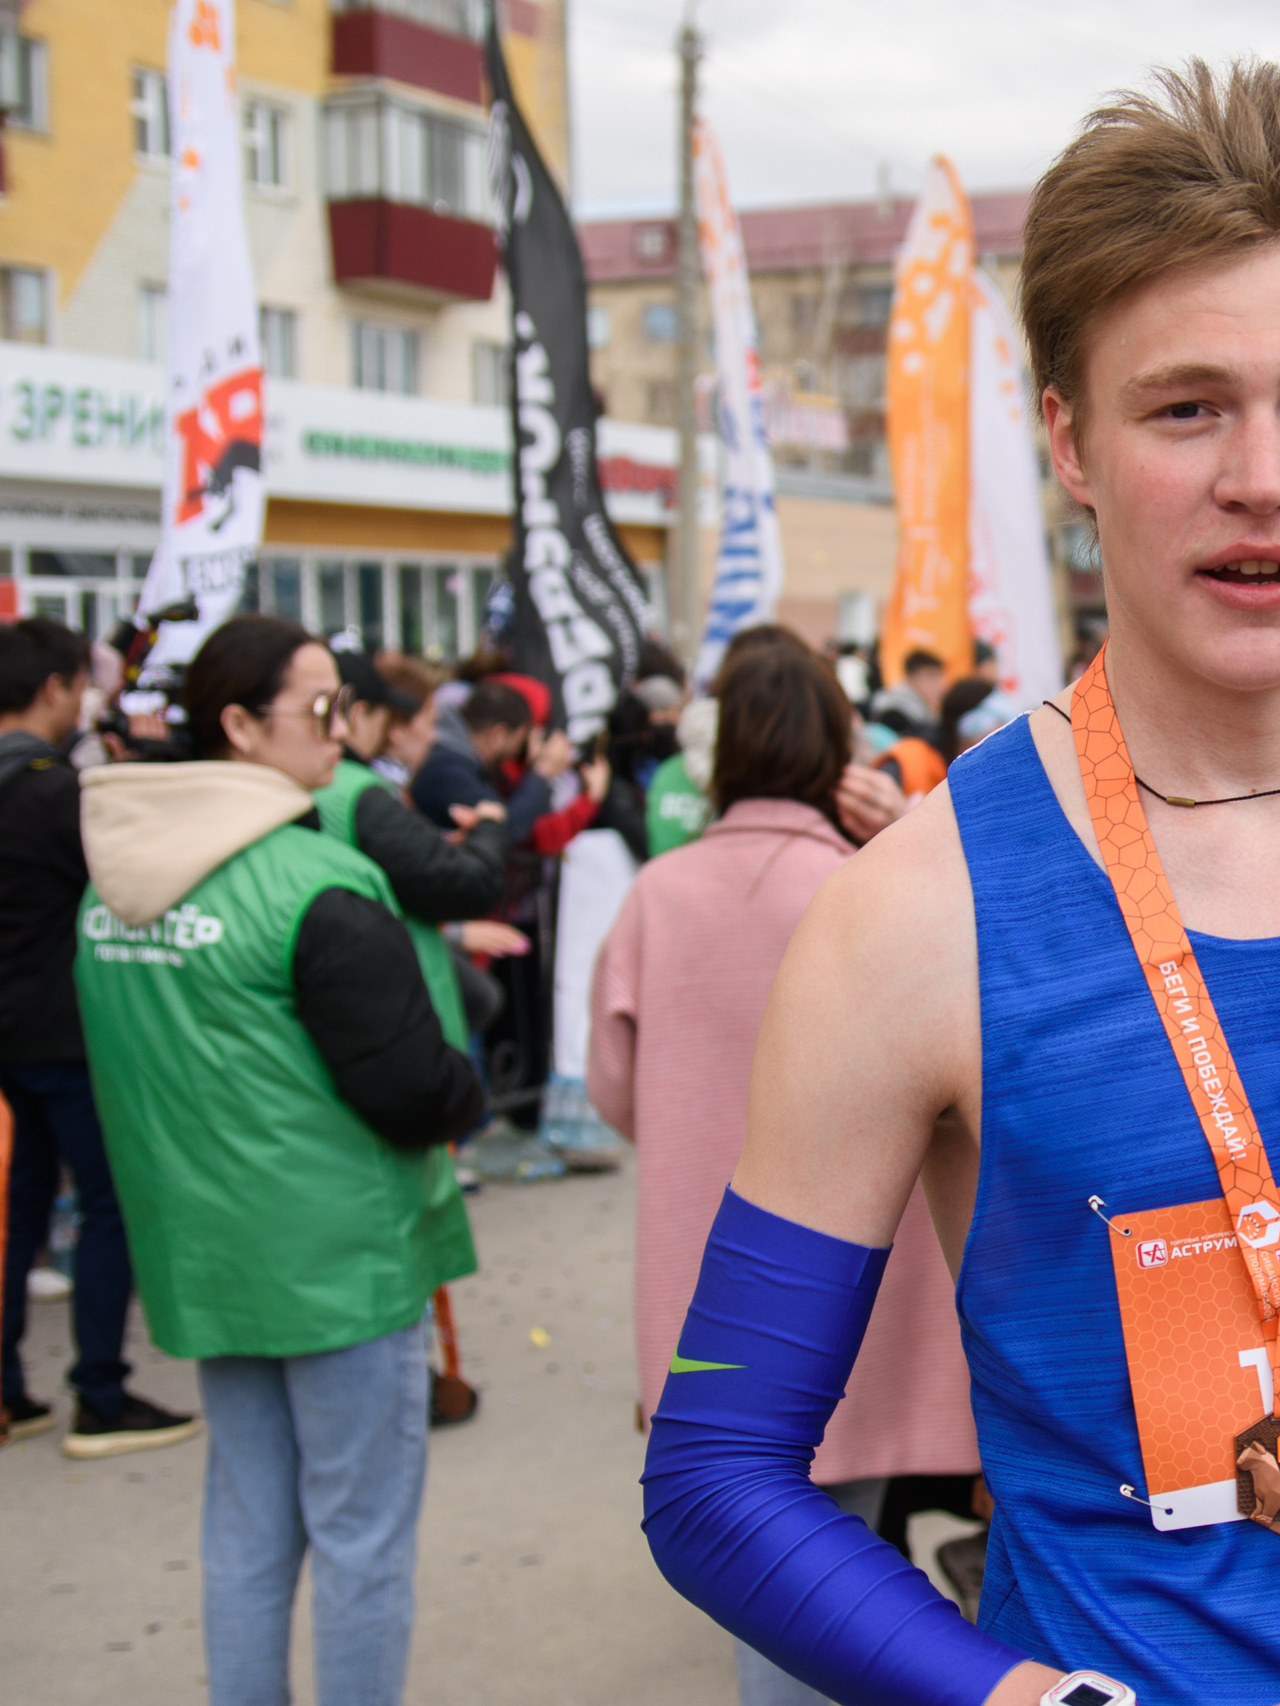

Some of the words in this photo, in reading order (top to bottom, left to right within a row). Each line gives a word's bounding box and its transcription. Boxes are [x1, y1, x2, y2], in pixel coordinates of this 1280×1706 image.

[1159, 960, 1192, 1014] БЕГИ
[1181, 1017, 1200, 1033] И
[1188, 1036, 1247, 1161] ПОБЕЖДАЙ!
[1170, 1236, 1238, 1259] АСТРУМ
[1248, 1254, 1273, 1321] ПОЛУМАРАФОН
